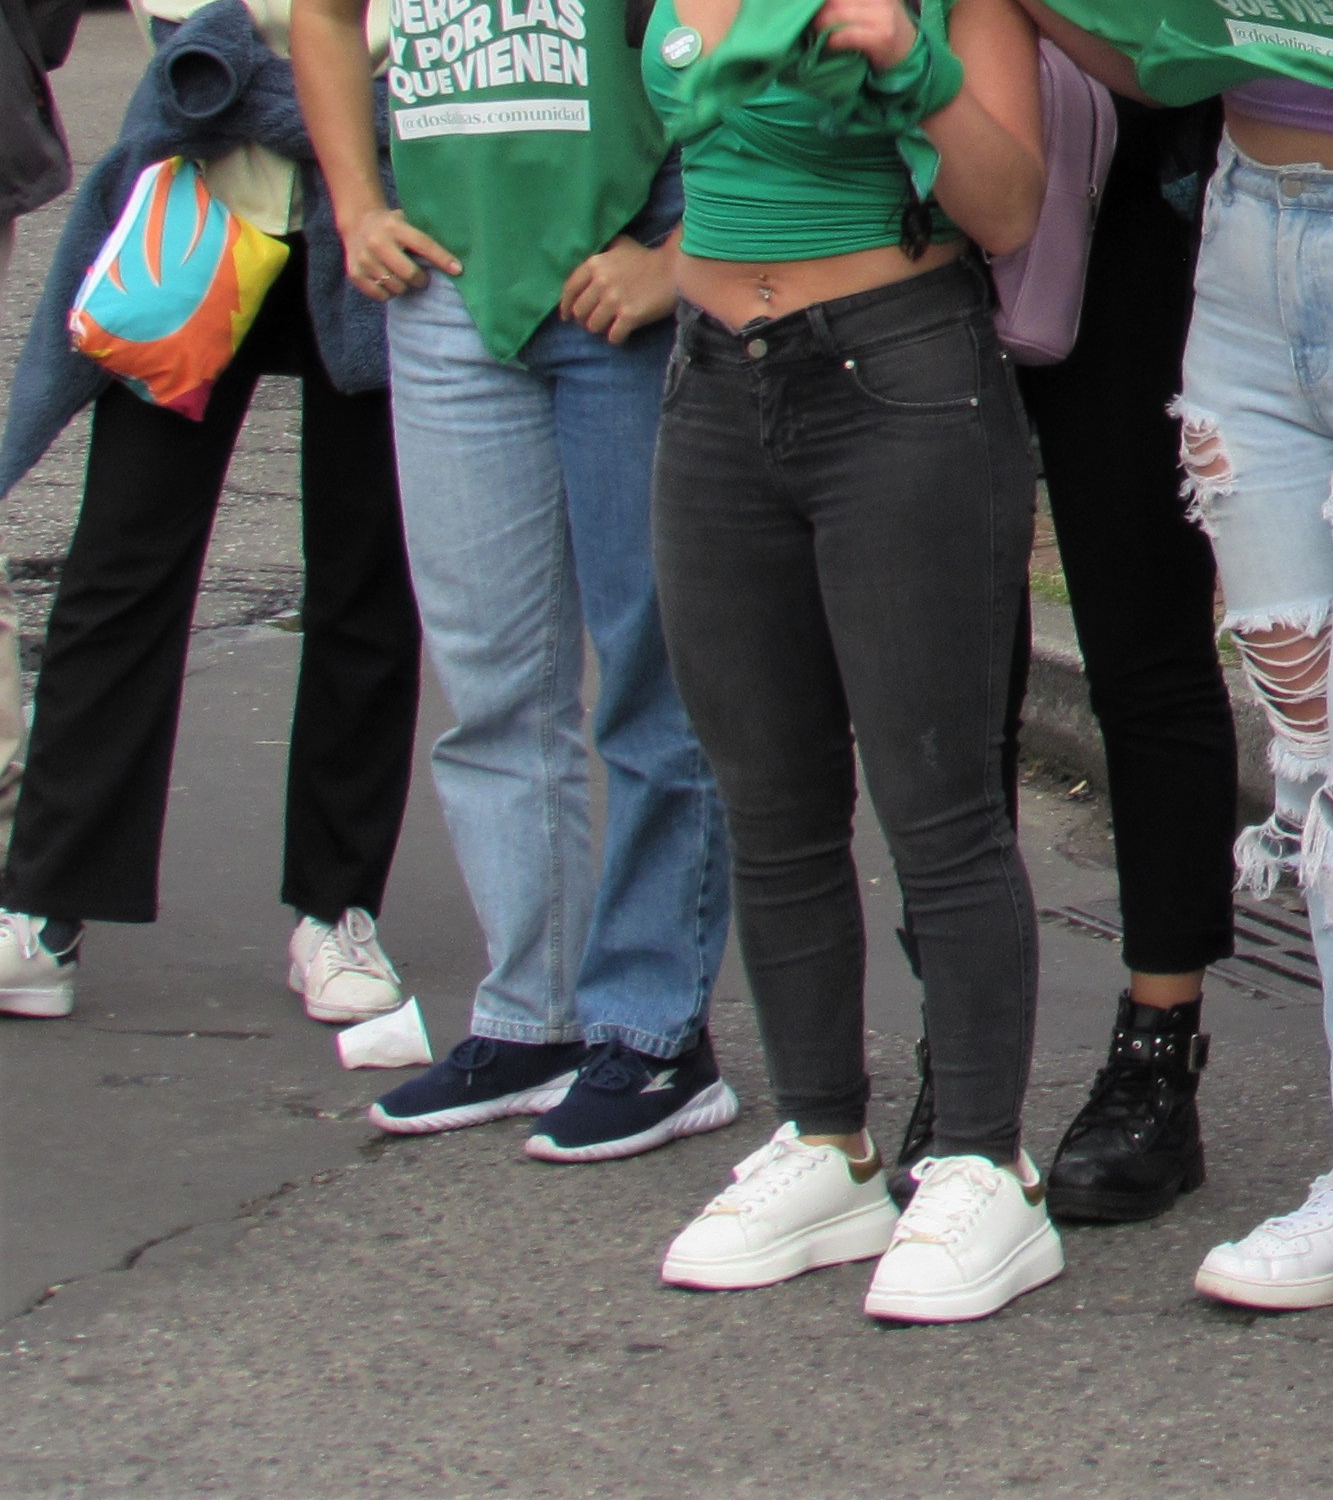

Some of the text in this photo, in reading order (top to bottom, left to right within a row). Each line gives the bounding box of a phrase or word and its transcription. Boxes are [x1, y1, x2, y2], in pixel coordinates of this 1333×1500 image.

[387, 32, 589, 105] QUE VIENEN
[414, 3, 494, 70] POR
